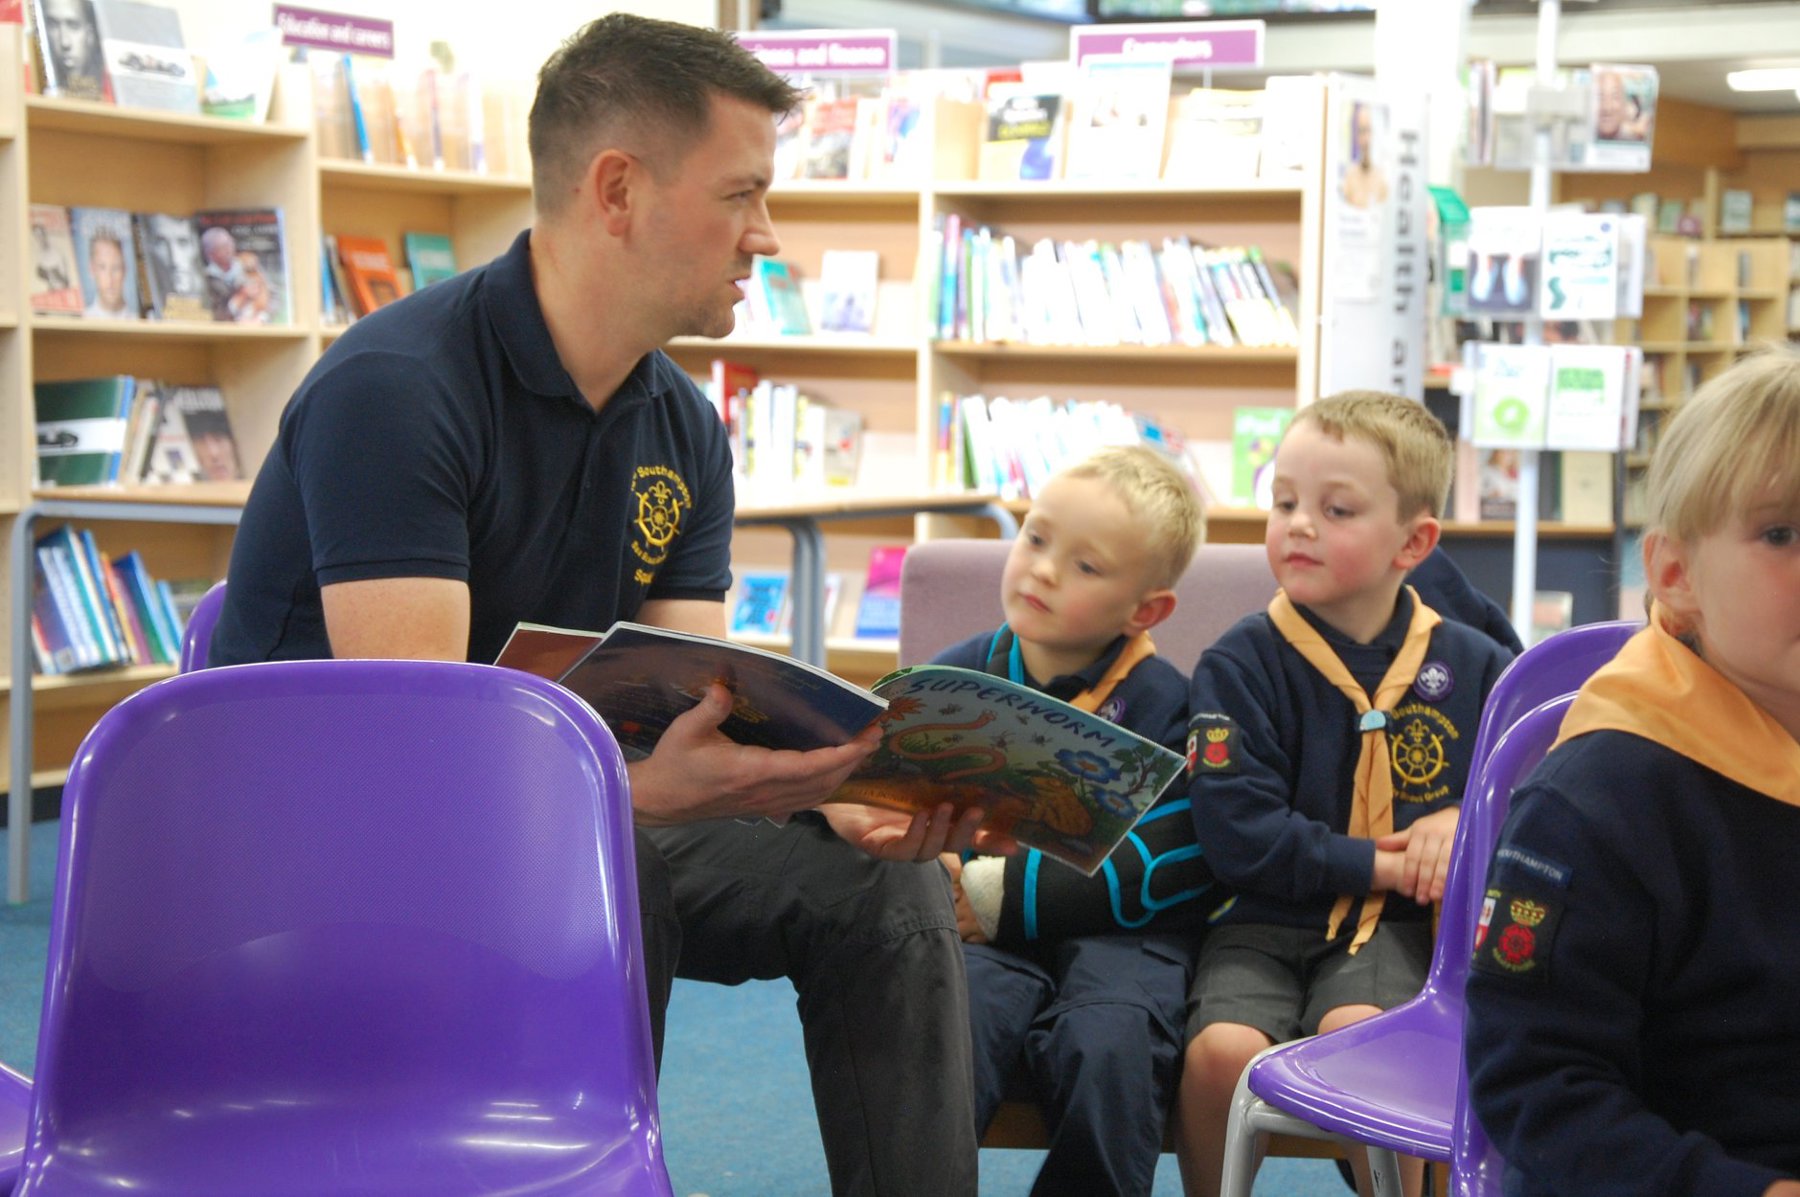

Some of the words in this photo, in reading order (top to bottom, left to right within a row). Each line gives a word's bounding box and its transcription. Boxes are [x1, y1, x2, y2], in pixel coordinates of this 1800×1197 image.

[330, 21, 352, 45] and
[352, 27, 392, 50] careers
[797, 42, 827, 65] and
[1393, 130, 1419, 313] Health
[904, 677, 1117, 749] SUPERWORM
